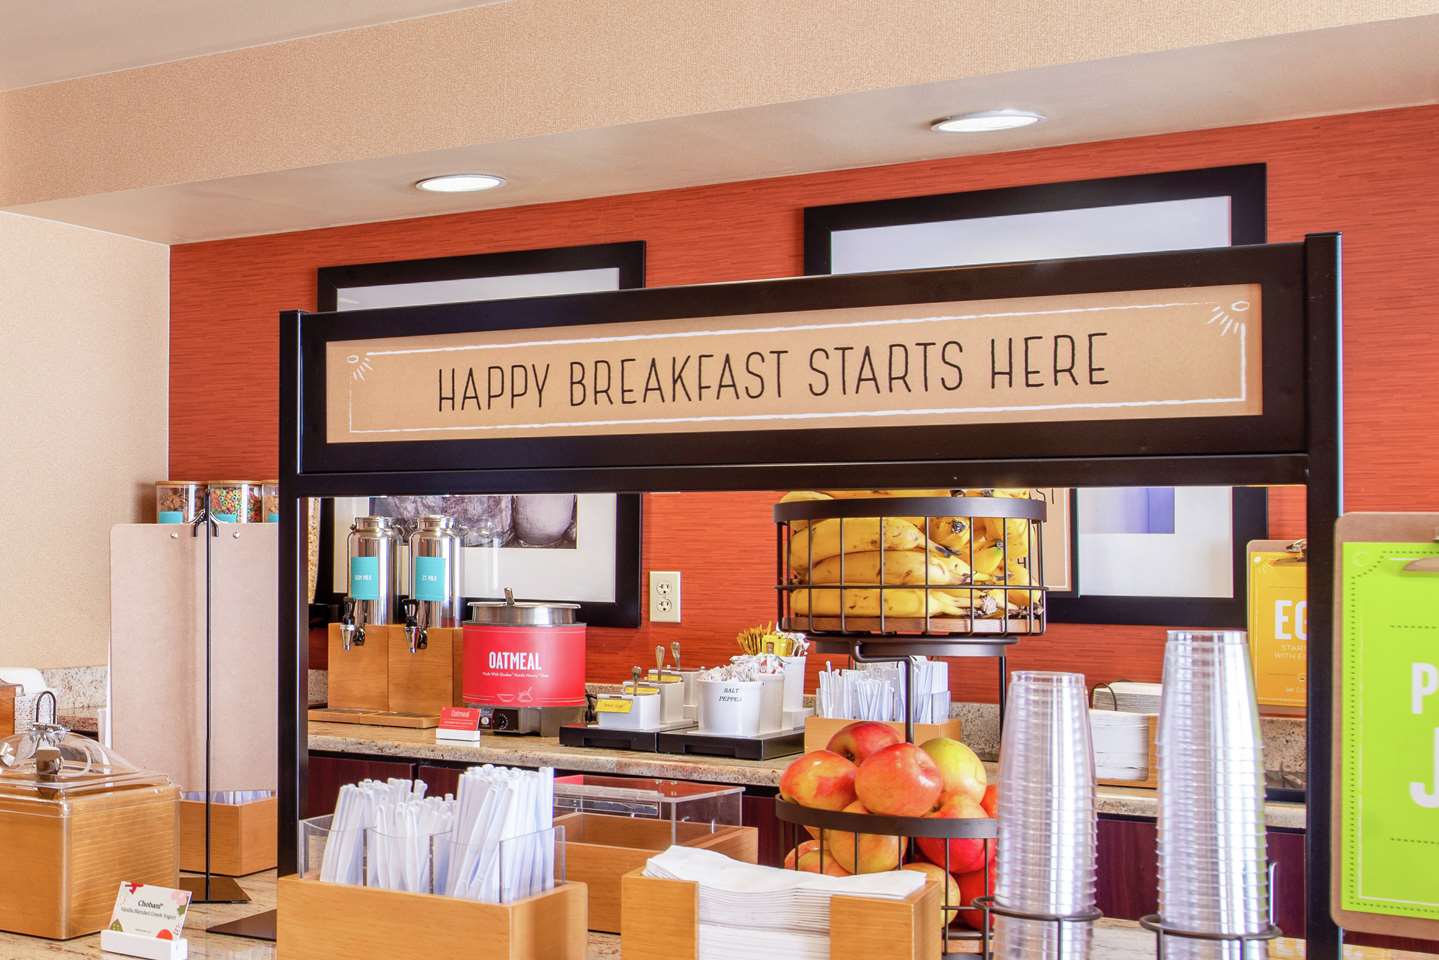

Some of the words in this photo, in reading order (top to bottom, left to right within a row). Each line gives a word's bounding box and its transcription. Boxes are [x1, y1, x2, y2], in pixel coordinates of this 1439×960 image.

[437, 362, 550, 413] HAPPY
[569, 350, 789, 407] BREAKFAST
[808, 340, 964, 397] STARTS
[990, 332, 1109, 389] HERE
[1275, 599, 1307, 640] EG
[488, 650, 543, 671] OATMEAL
